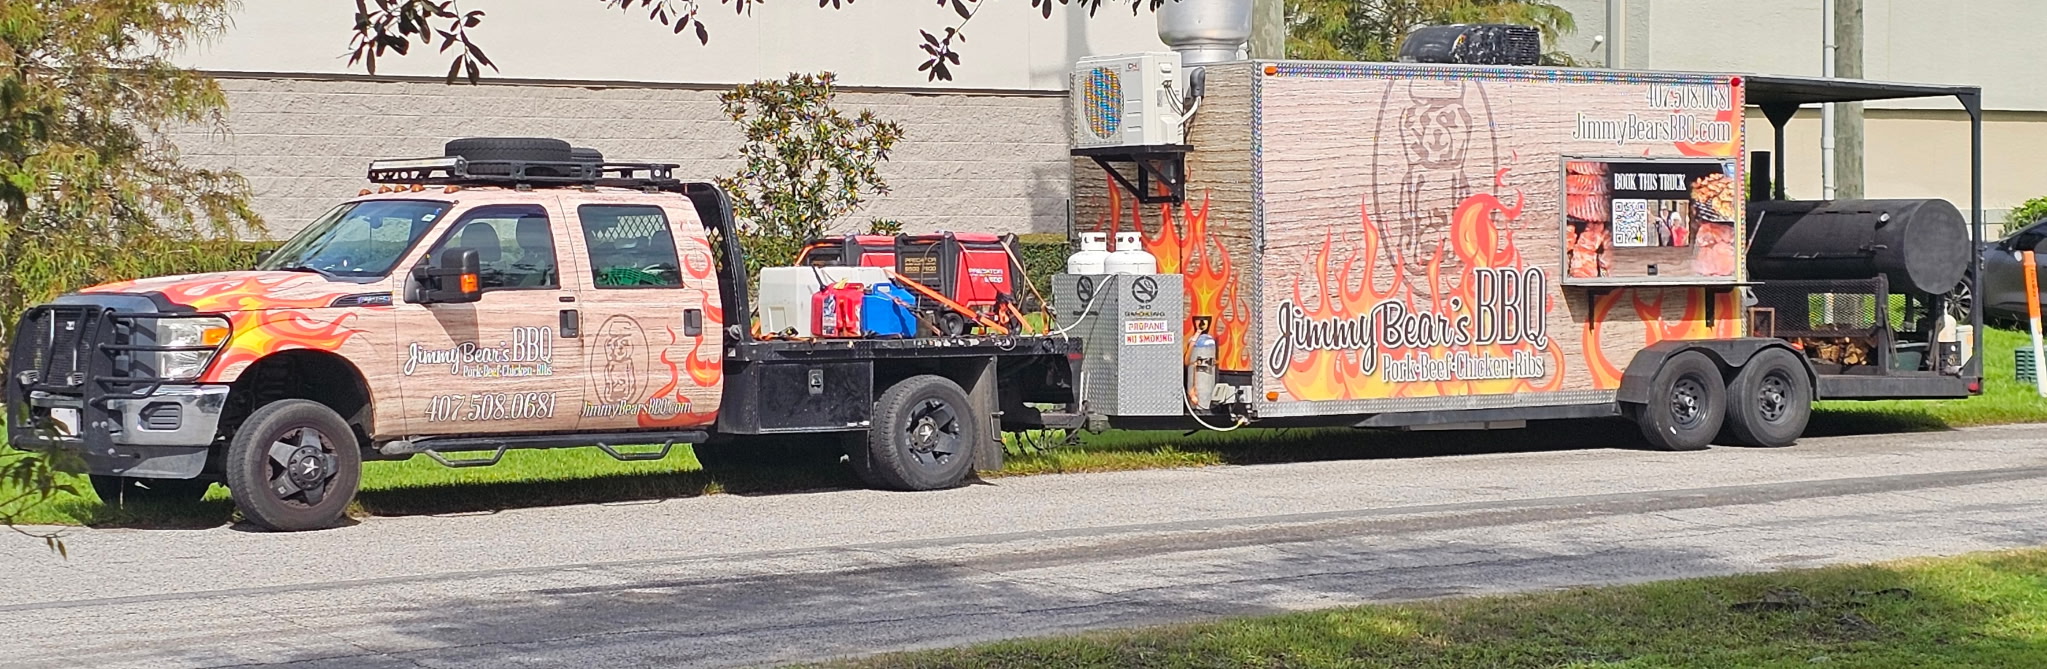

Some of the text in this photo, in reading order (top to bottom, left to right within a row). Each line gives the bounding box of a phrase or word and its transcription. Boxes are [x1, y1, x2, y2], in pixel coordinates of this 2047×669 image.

[1646, 85, 1732, 111] 407.508.0681
[1572, 112, 1732, 146] JimmyBearsBBQ.com
[1614, 173, 1687, 191] BOOK THIS TRUCK
[1474, 266, 1548, 349] BBQ
[1126, 334, 1173, 343] NO SMOKING
[1128, 321, 1165, 330] PROPANE
[512, 326, 553, 363] BBQ
[424, 391, 557, 422] 407.508.0681
[579, 397, 692, 419] JimmyBearsBBQ.com
